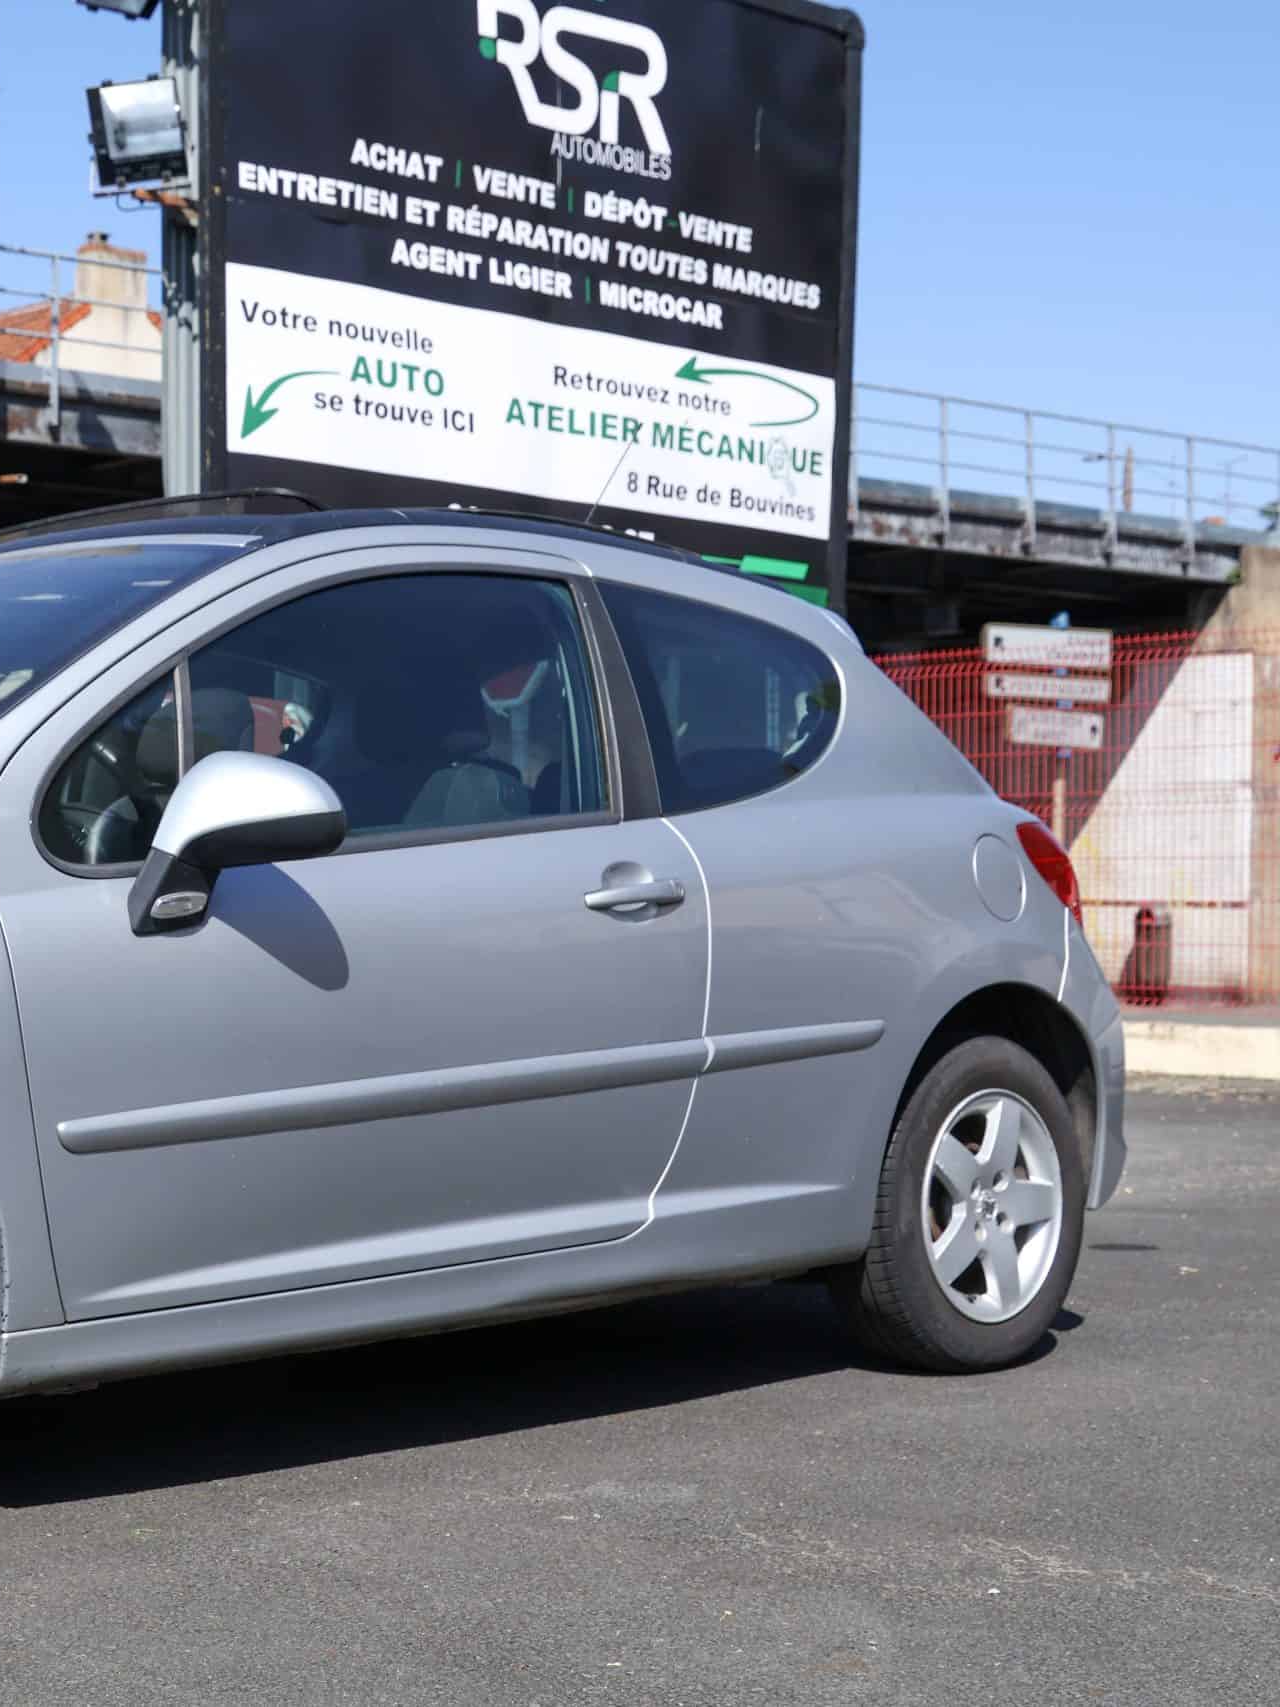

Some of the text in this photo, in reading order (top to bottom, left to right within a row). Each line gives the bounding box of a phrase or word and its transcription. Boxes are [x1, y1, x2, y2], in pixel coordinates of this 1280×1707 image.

[477, 0, 672, 155] RSR
[350, 138, 443, 183] ACHAT
[472, 164, 556, 209] VENTE
[550, 131, 672, 181] AUTOMOBILES
[237, 161, 821, 310] ENTRETIEN ET RÉPARATION TOUTES MARQUES
[390, 238, 724, 330] AGENT LIGIER MICROCAR
[240, 299, 434, 354] Votre nouvelle
[350, 355, 445, 397] AUTO
[552, 364, 732, 416] Retrouvez notre
[313, 391, 475, 433] se trouve ICI
[505, 397, 640, 445] ATELIER
[626, 471, 817, 522] 8 Rue de Bouvines
